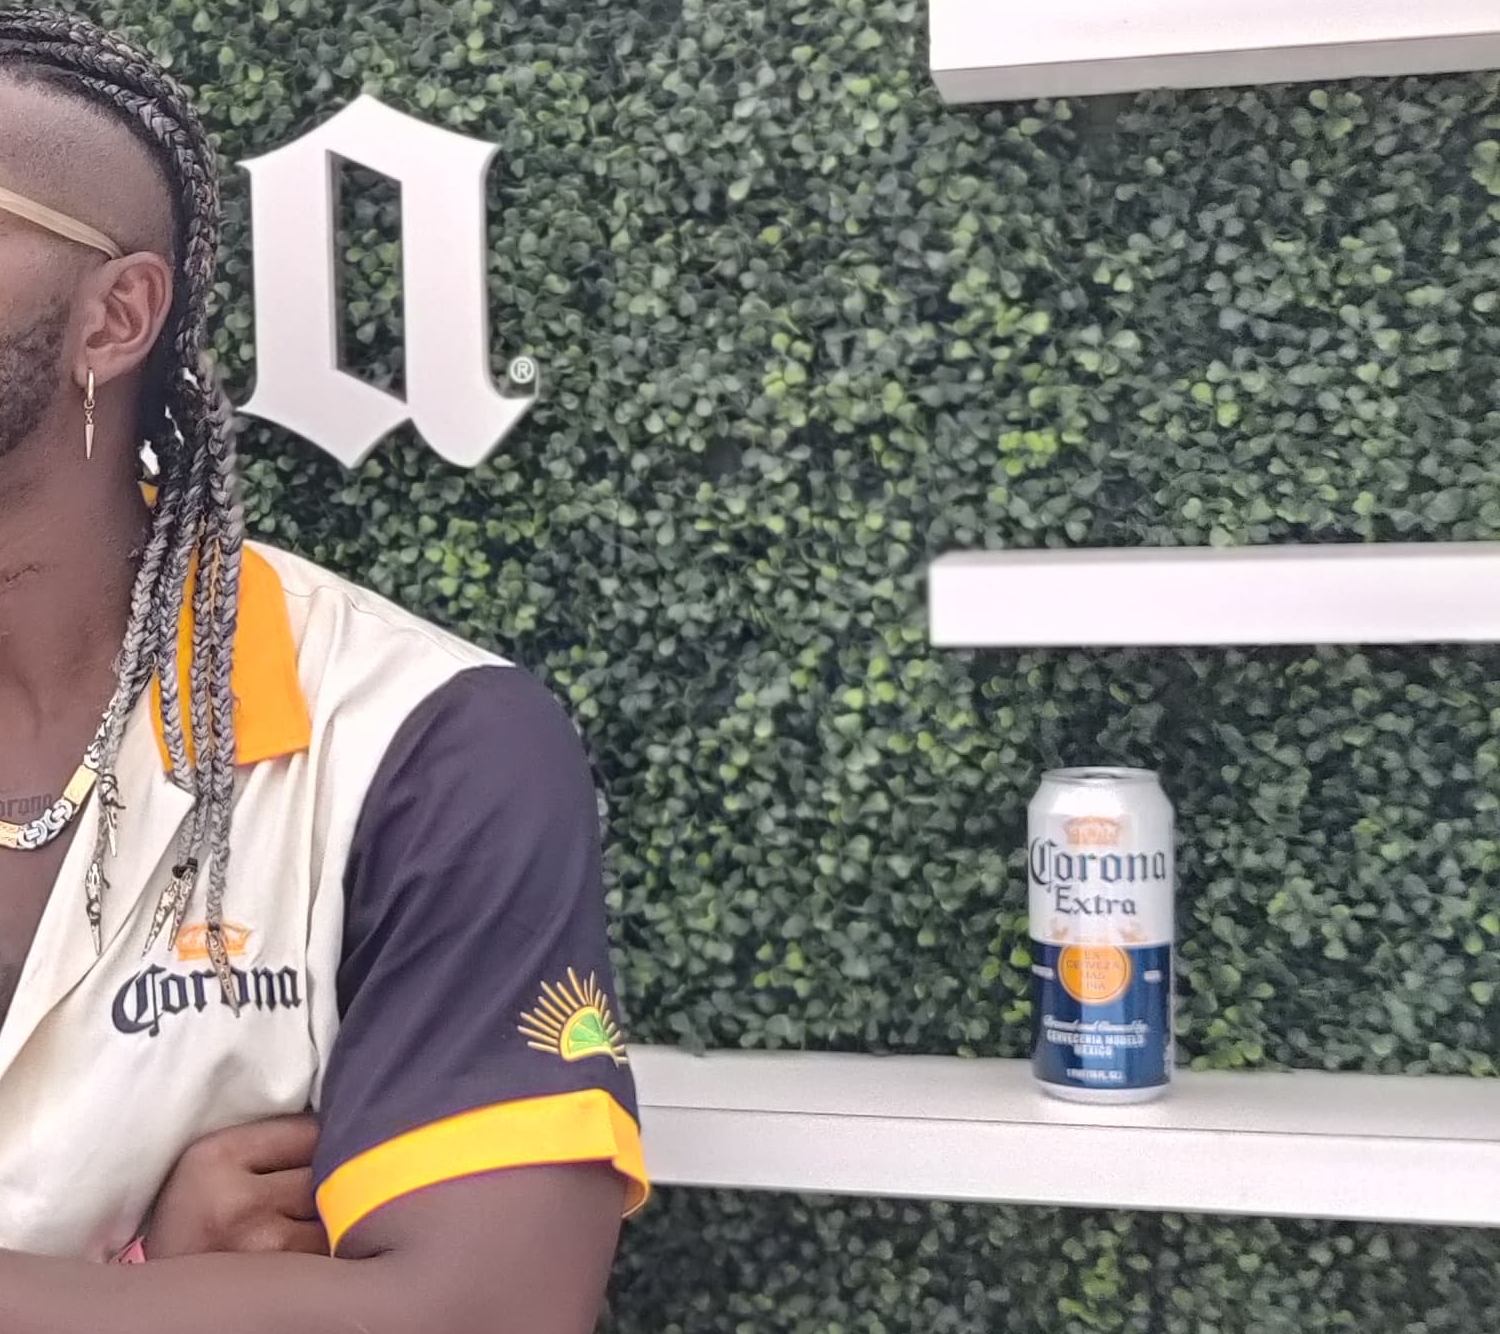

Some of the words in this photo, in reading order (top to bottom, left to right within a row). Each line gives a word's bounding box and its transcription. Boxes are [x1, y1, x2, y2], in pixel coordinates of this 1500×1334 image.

[1030, 837, 1167, 894] Corona
[1054, 884, 1137, 916] Extra
[111, 963, 302, 1037] Corona
